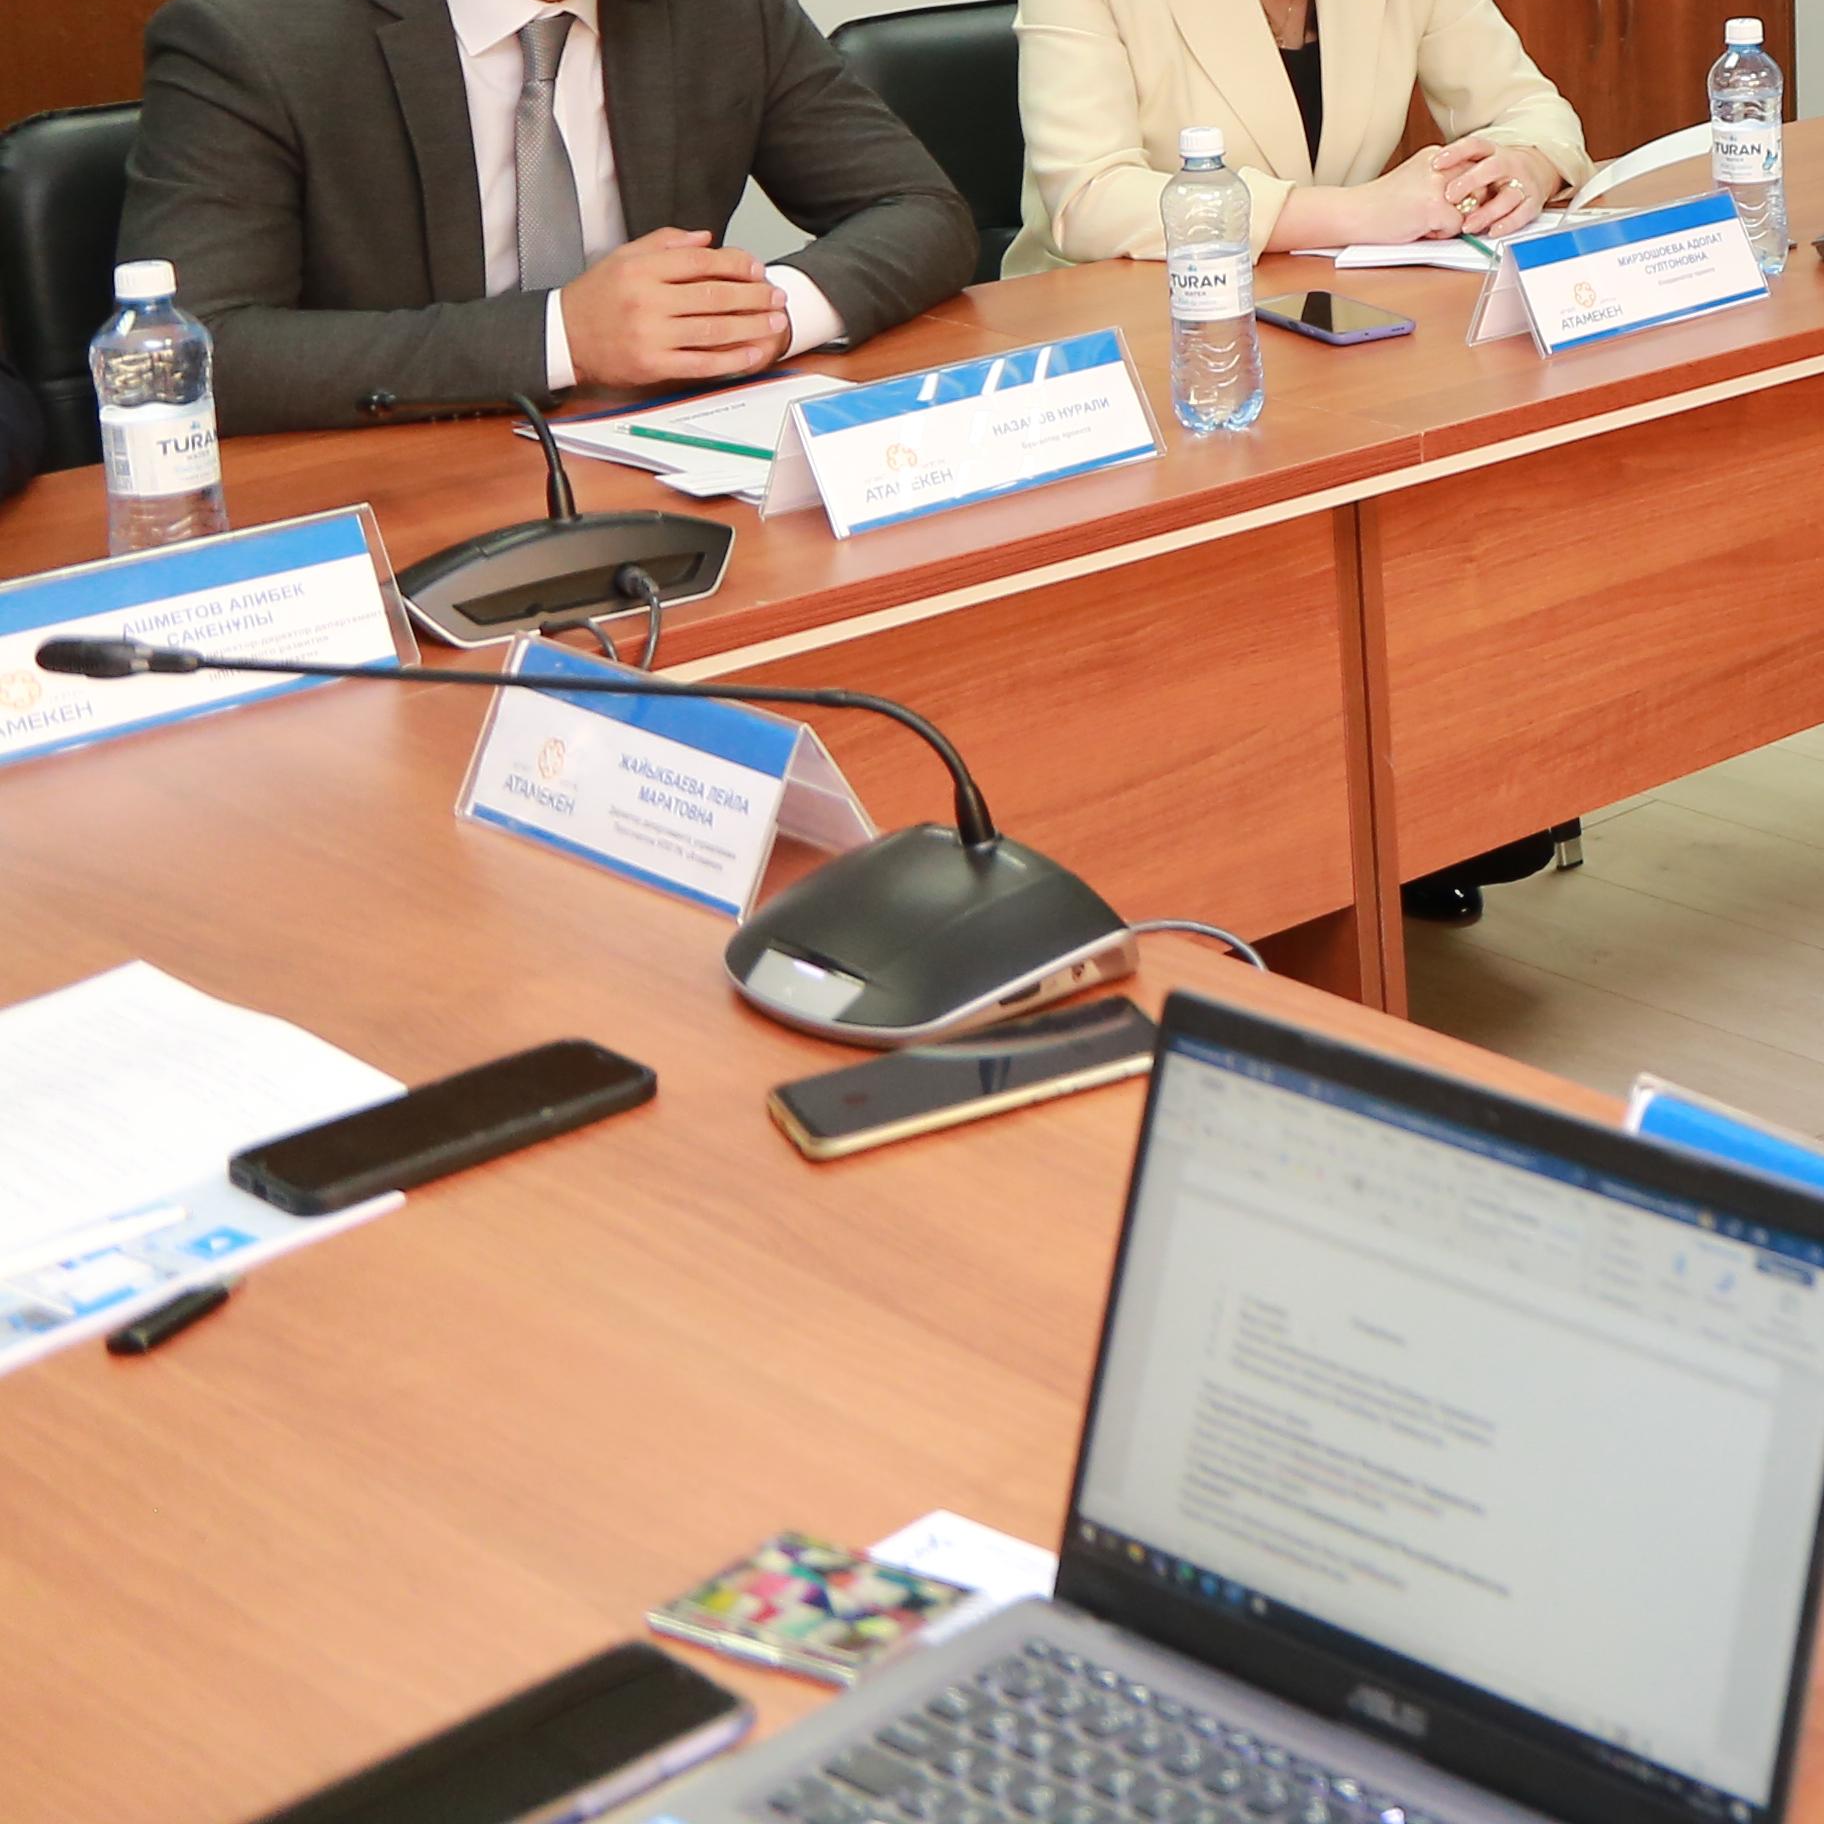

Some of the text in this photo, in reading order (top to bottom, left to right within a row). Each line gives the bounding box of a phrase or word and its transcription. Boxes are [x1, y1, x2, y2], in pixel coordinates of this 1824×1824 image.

[1714, 141, 1762, 156] TURAN
[1617, 232, 1723, 267] МИРЗОШОЕВА АДОЛАТ
[1645, 252, 1708, 275] СУЛТОНОВНА
[1171, 273, 1226, 289] TURAN
[1561, 304, 1625, 331] АТАМЕКЕН
[1058, 396, 1111, 421] НУРАЛИ
[864, 467, 954, 504] АТАЕКЕН
[122, 582, 306, 639] АШМЕТОВ АЛИБЕК
[0, 700, 94, 738] МЕКЕН
[503, 773, 576, 817] АТАМЕКЕН
[638, 785, 714, 830] МАРАТОВНА
